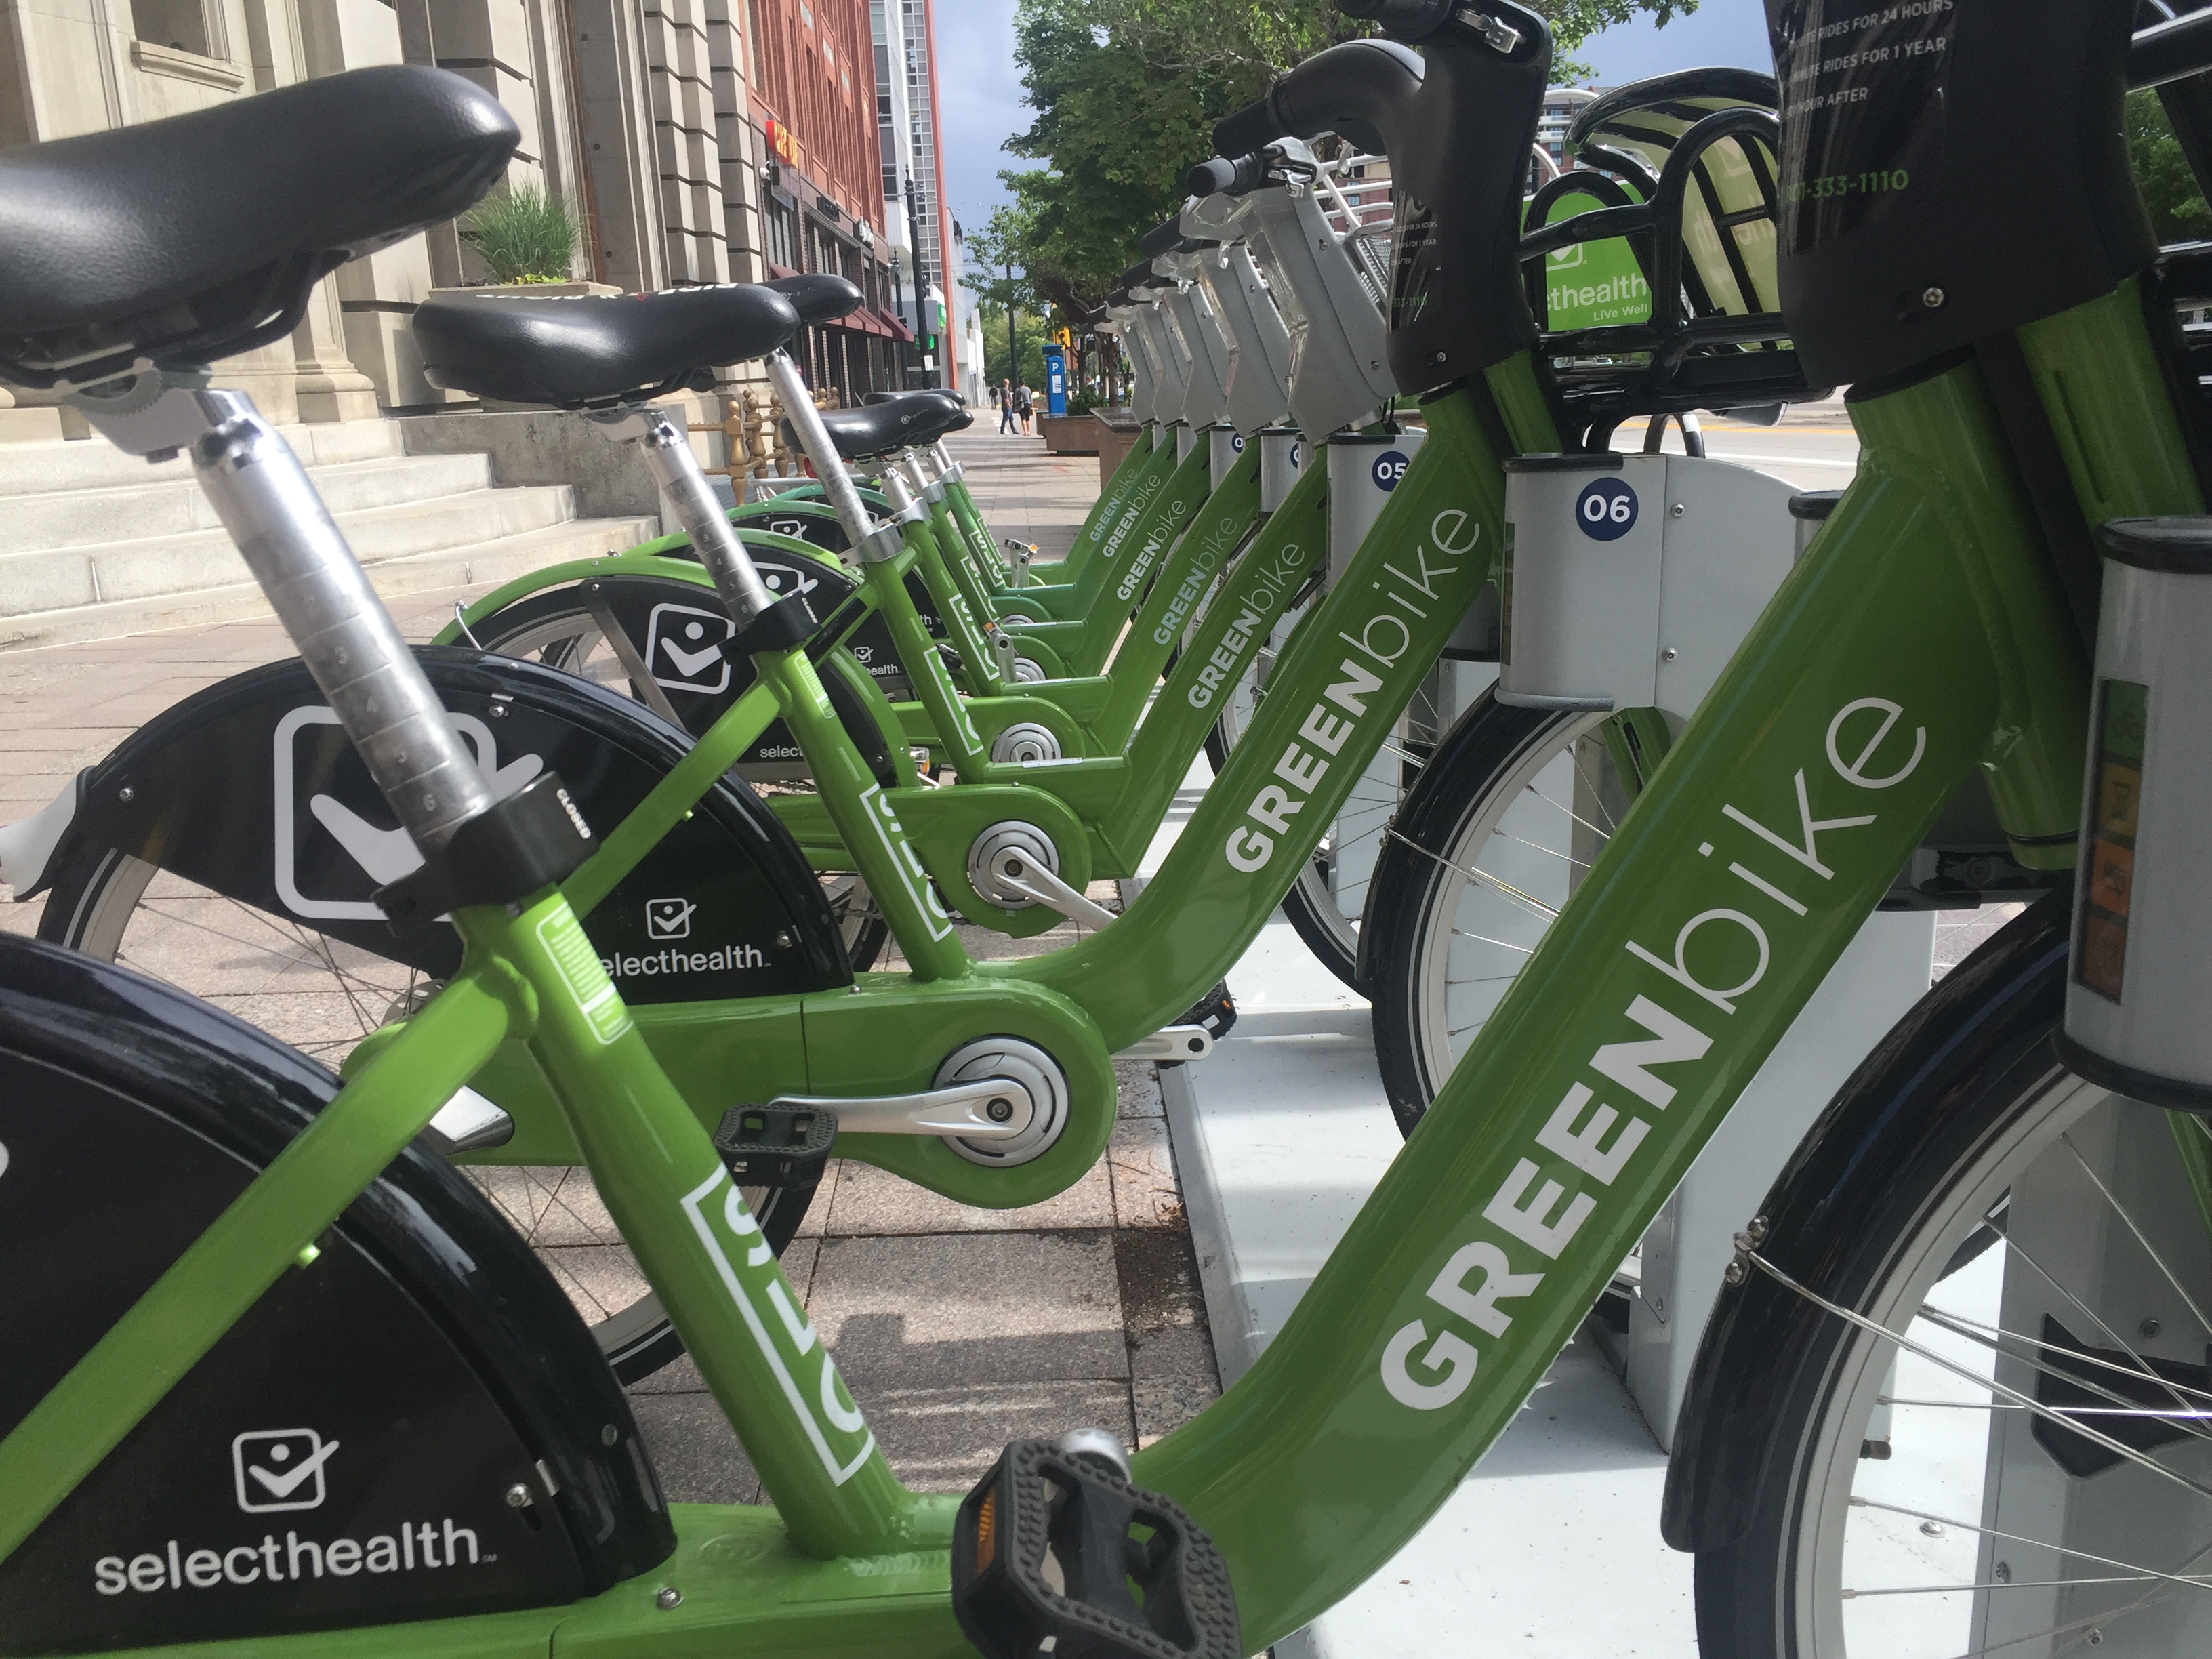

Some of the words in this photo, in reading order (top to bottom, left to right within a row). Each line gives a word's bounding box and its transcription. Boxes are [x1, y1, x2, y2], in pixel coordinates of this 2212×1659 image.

[1818, 20, 1850, 40] RIDES
[1852, 13, 1878, 32] FOR
[1881, 7, 1898, 24] 24
[1902, 0, 1953, 19] HOURS
[1823, 54, 1858, 74] RIDES
[1862, 48, 1889, 65] FOR
[1893, 45, 1899, 58] 1
[1904, 37, 1947, 57] YEAR
[1828, 87, 1868, 106] AFTER
[1422, 238, 1437, 246] YEAR
[1622, 303, 1647, 316] Well
[1052, 363, 1059, 372] P
[1377, 462, 1407, 480] 05
[1089, 468, 1139, 541] GREENbike
[1102, 474, 1161, 558] GREENbike
[1582, 493, 1631, 523] 06
[1116, 500, 1186, 600] GREENbike
[1153, 517, 1237, 645] GREENbike
[1187, 544, 1305, 708] GREENbike
[1225, 509, 1480, 873] GREENbike
[600, 943, 762, 978] electhealth
[1380, 697, 1926, 1411] GREENbike
[94, 1518, 479, 1596] selecthealth
